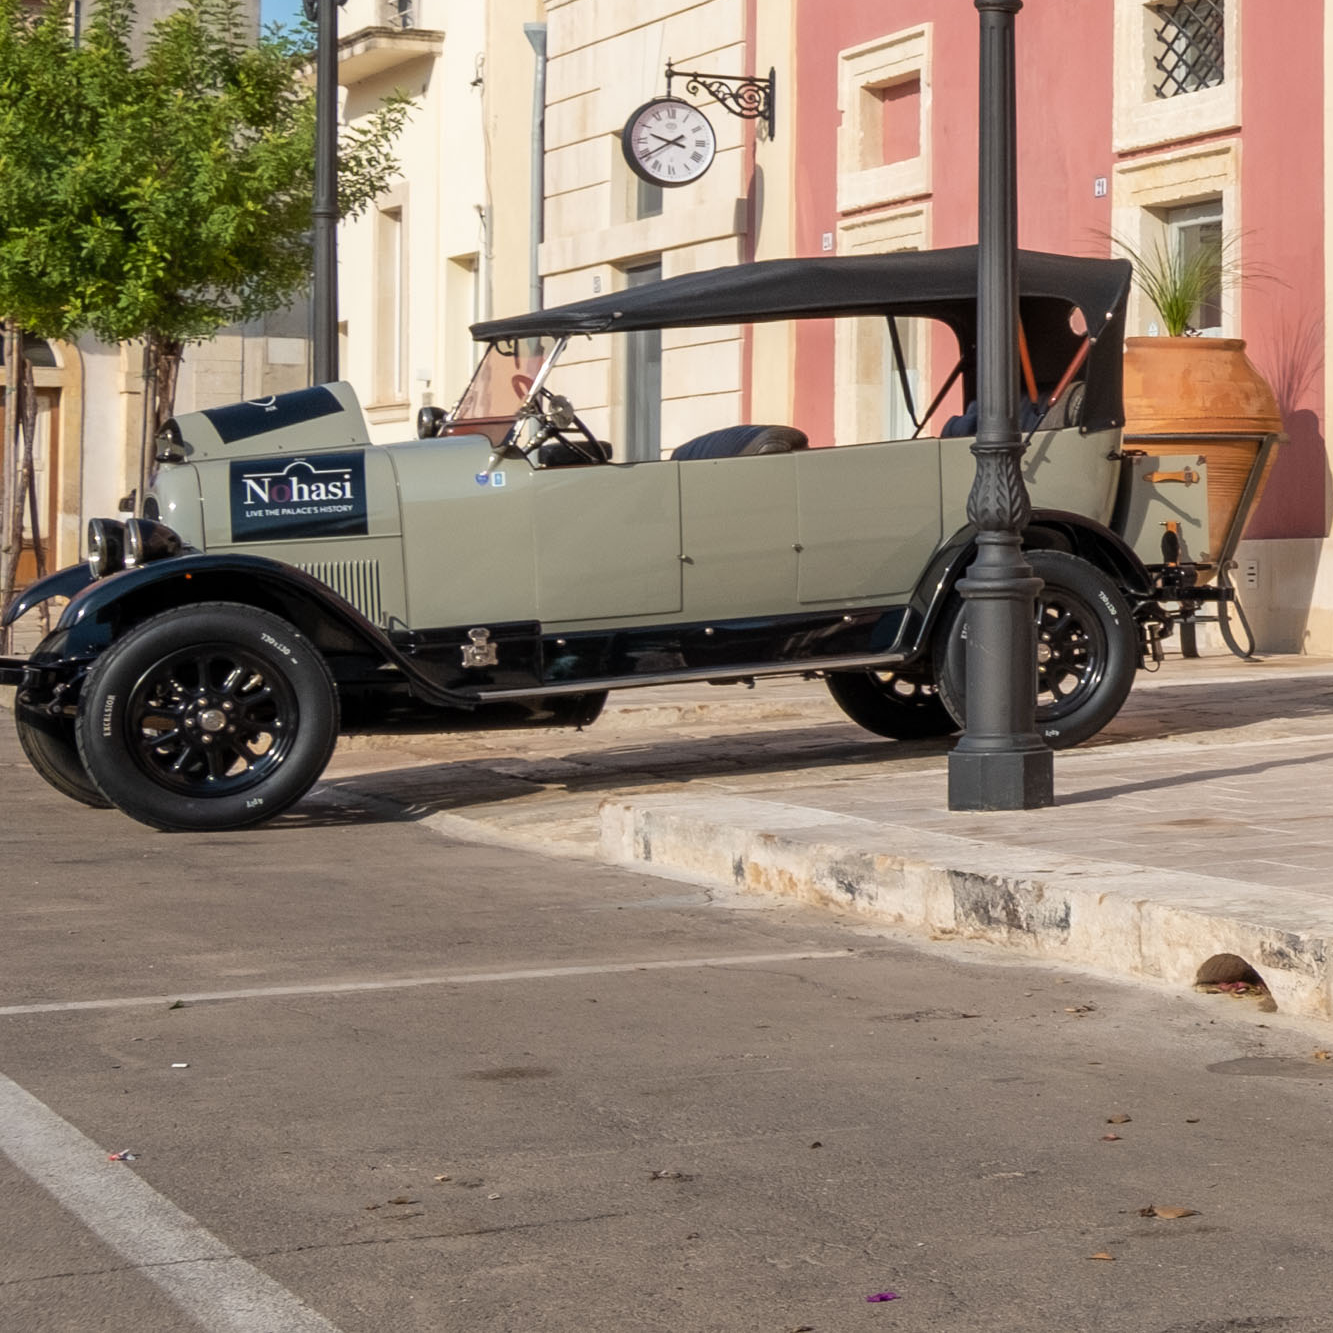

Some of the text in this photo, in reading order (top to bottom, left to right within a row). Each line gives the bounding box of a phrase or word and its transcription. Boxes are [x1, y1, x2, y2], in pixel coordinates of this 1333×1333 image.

[241, 473, 355, 505] Nohasi
[245, 504, 353, 518] LIVE THE PALACE'S HISTORY
[103, 694, 116, 737] EXCELSIOR
